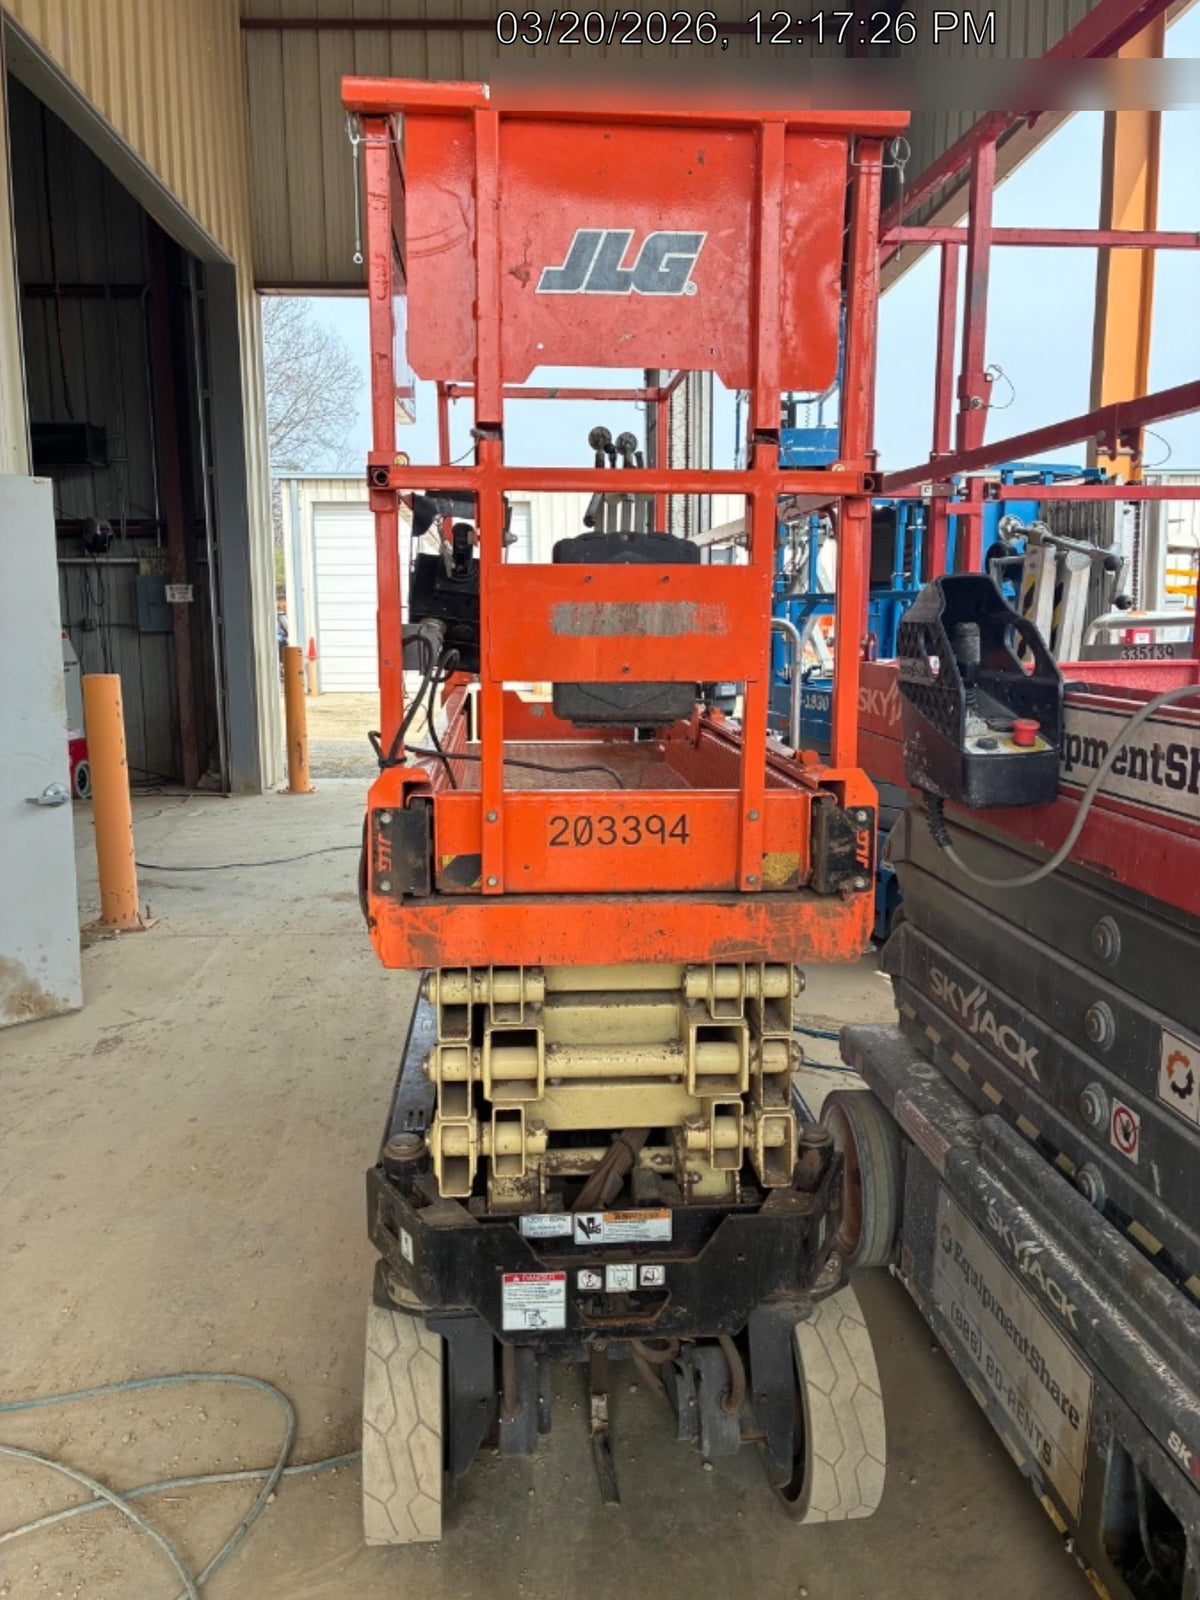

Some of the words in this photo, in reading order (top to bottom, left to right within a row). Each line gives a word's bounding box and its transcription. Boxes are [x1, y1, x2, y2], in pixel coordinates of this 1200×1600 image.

[1121, 644, 1175, 660] 335139
[548, 813, 691, 847] 203394
[855, 829, 870, 869] JLG
[930, 967, 1041, 1082] SKYJACK
[987, 1206, 1079, 1331] SKYJACK
[952, 1240, 1081, 1430] EquipmentShare
[1167, 1430, 1200, 1478] SK
